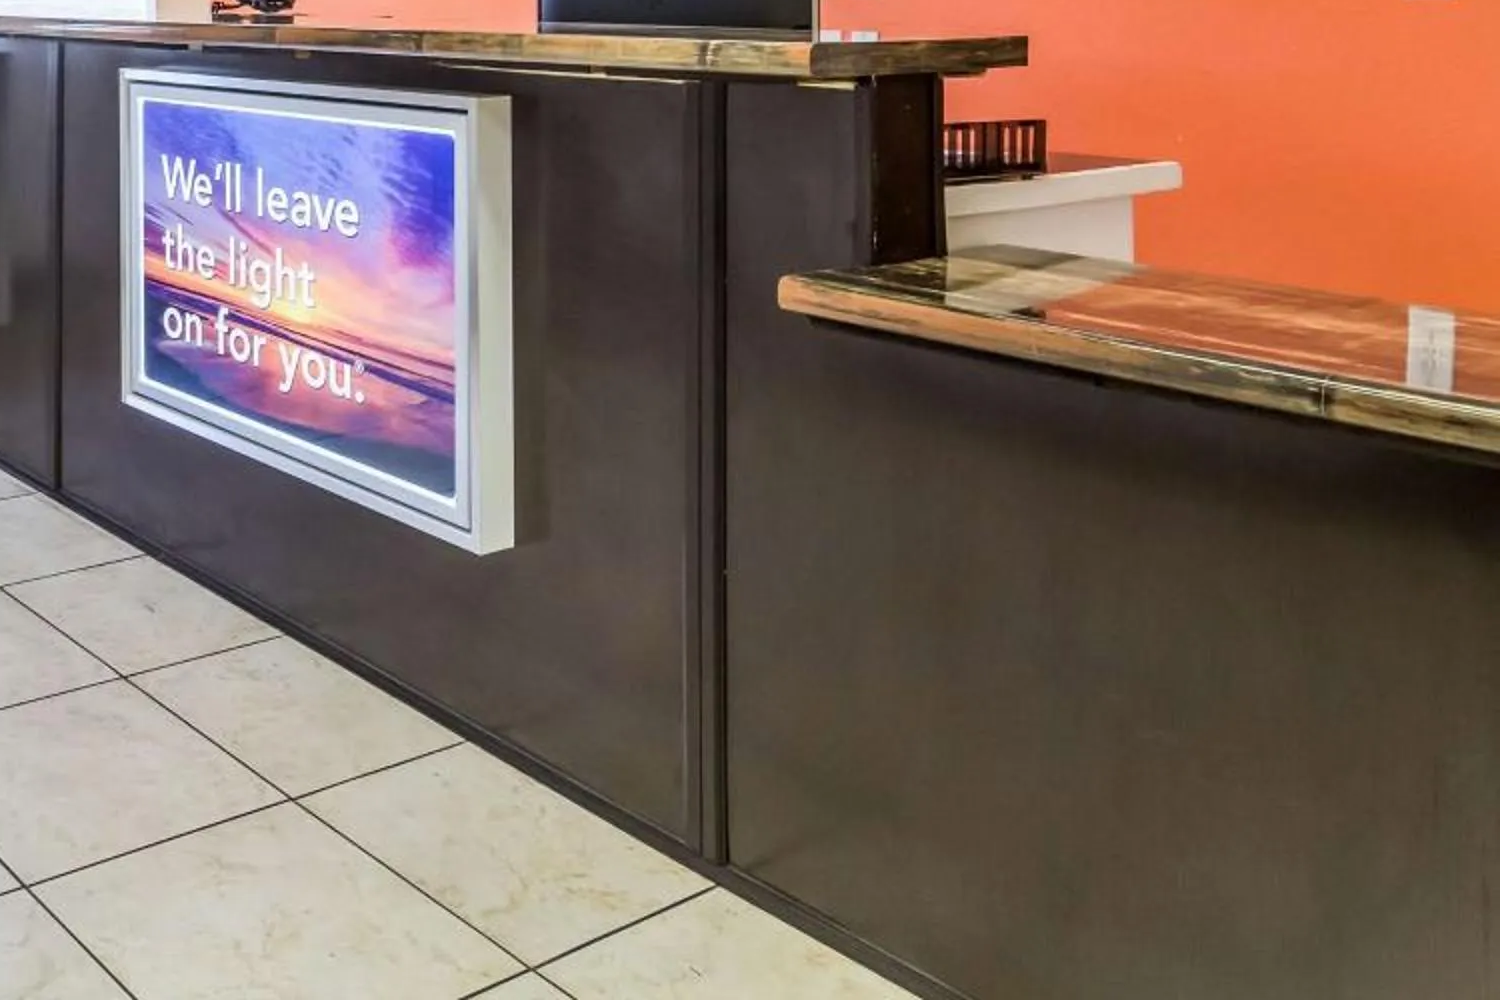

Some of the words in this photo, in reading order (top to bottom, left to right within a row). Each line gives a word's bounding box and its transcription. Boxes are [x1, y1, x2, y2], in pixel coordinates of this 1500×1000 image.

[256, 167, 360, 238] leave
[161, 222, 215, 280] the
[227, 236, 317, 310] light
[162, 306, 204, 347] on
[214, 307, 266, 368] for
